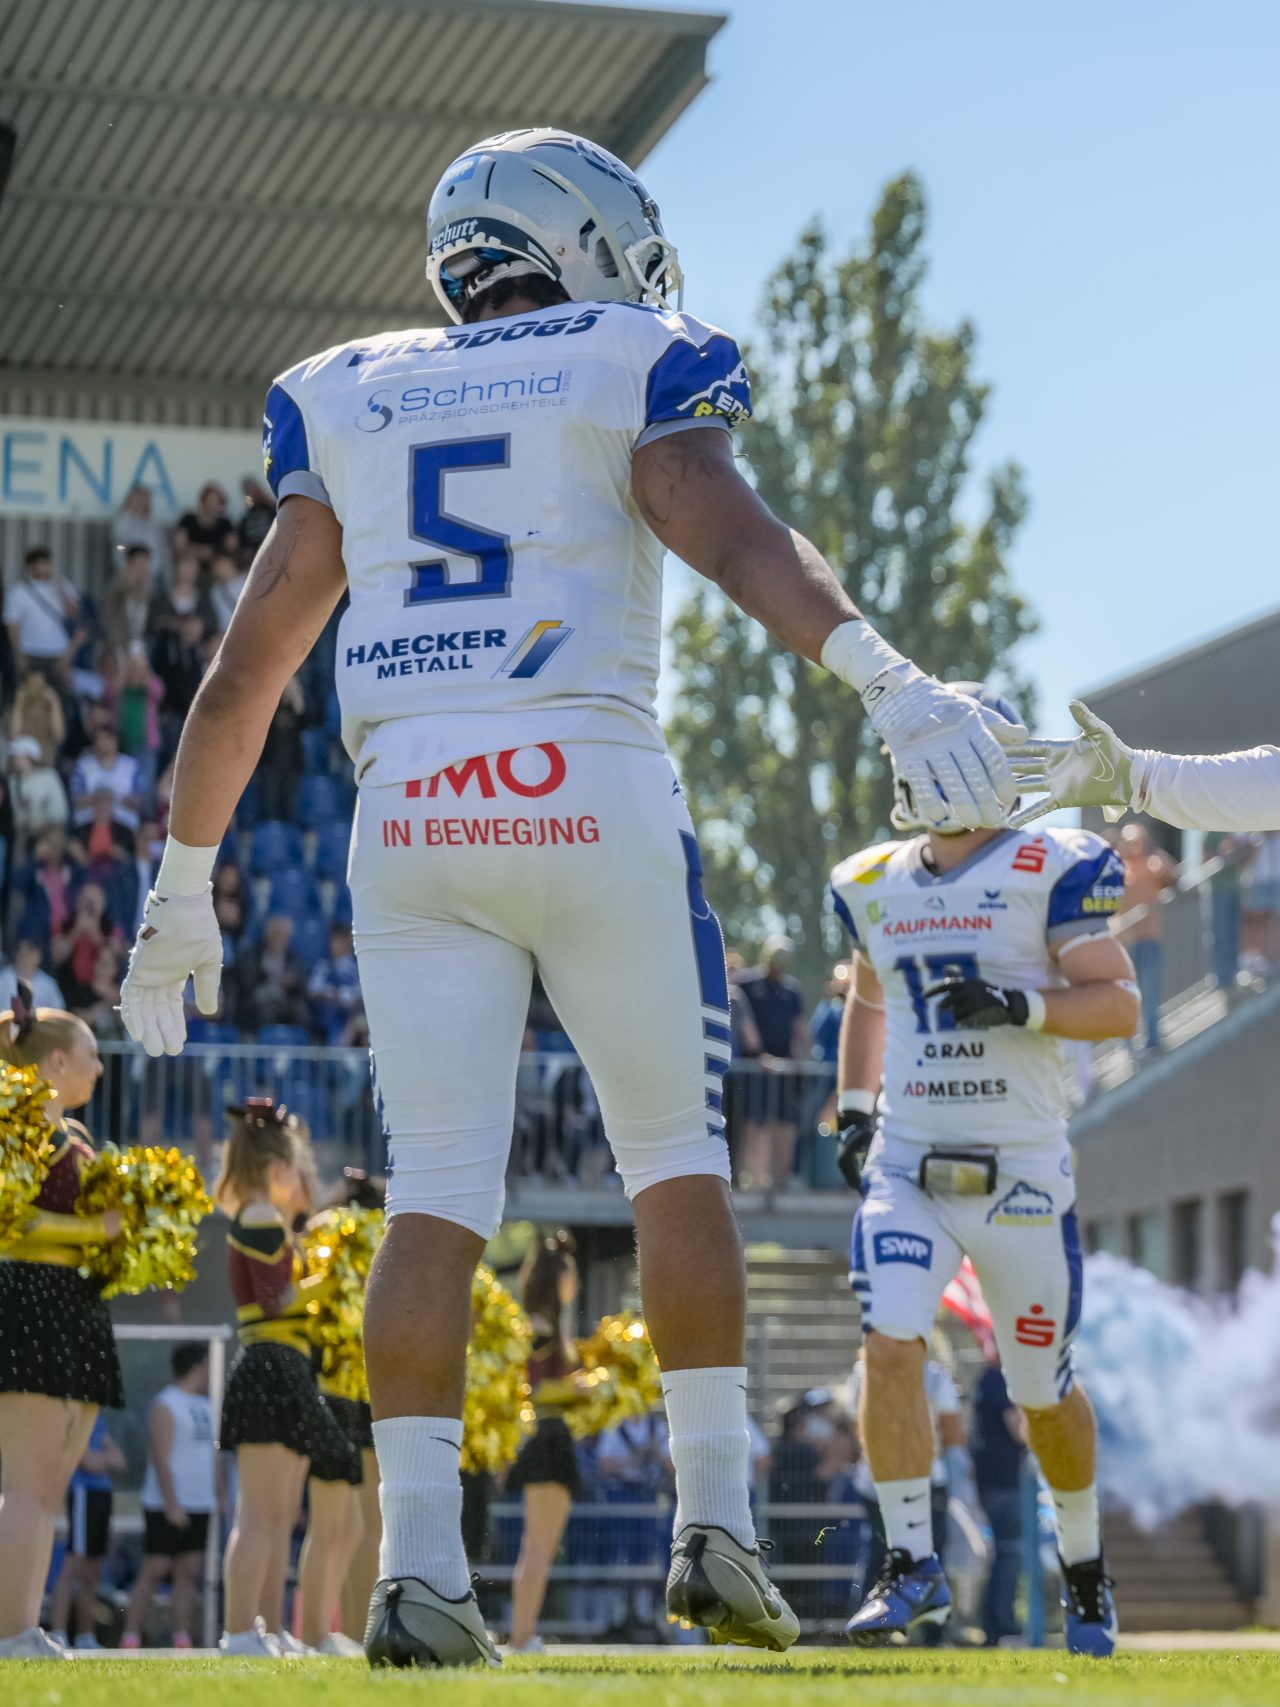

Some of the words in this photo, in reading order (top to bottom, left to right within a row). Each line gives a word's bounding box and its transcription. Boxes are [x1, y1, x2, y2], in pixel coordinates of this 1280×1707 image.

[401, 371, 562, 411] Schmid
[399, 397, 567, 425] PRÄZISIONSDREHTEILE
[403, 432, 514, 608] 5
[346, 628, 507, 667] HAECKER
[377, 654, 473, 679] METALL
[405, 741, 567, 798] MO
[383, 819, 411, 847] IN
[425, 815, 600, 846] BEWEGUNG
[883, 914, 993, 936] KAUFMANN
[903, 1078, 1007, 1097] ADMEDES
[879, 1236, 929, 1259] SWP
